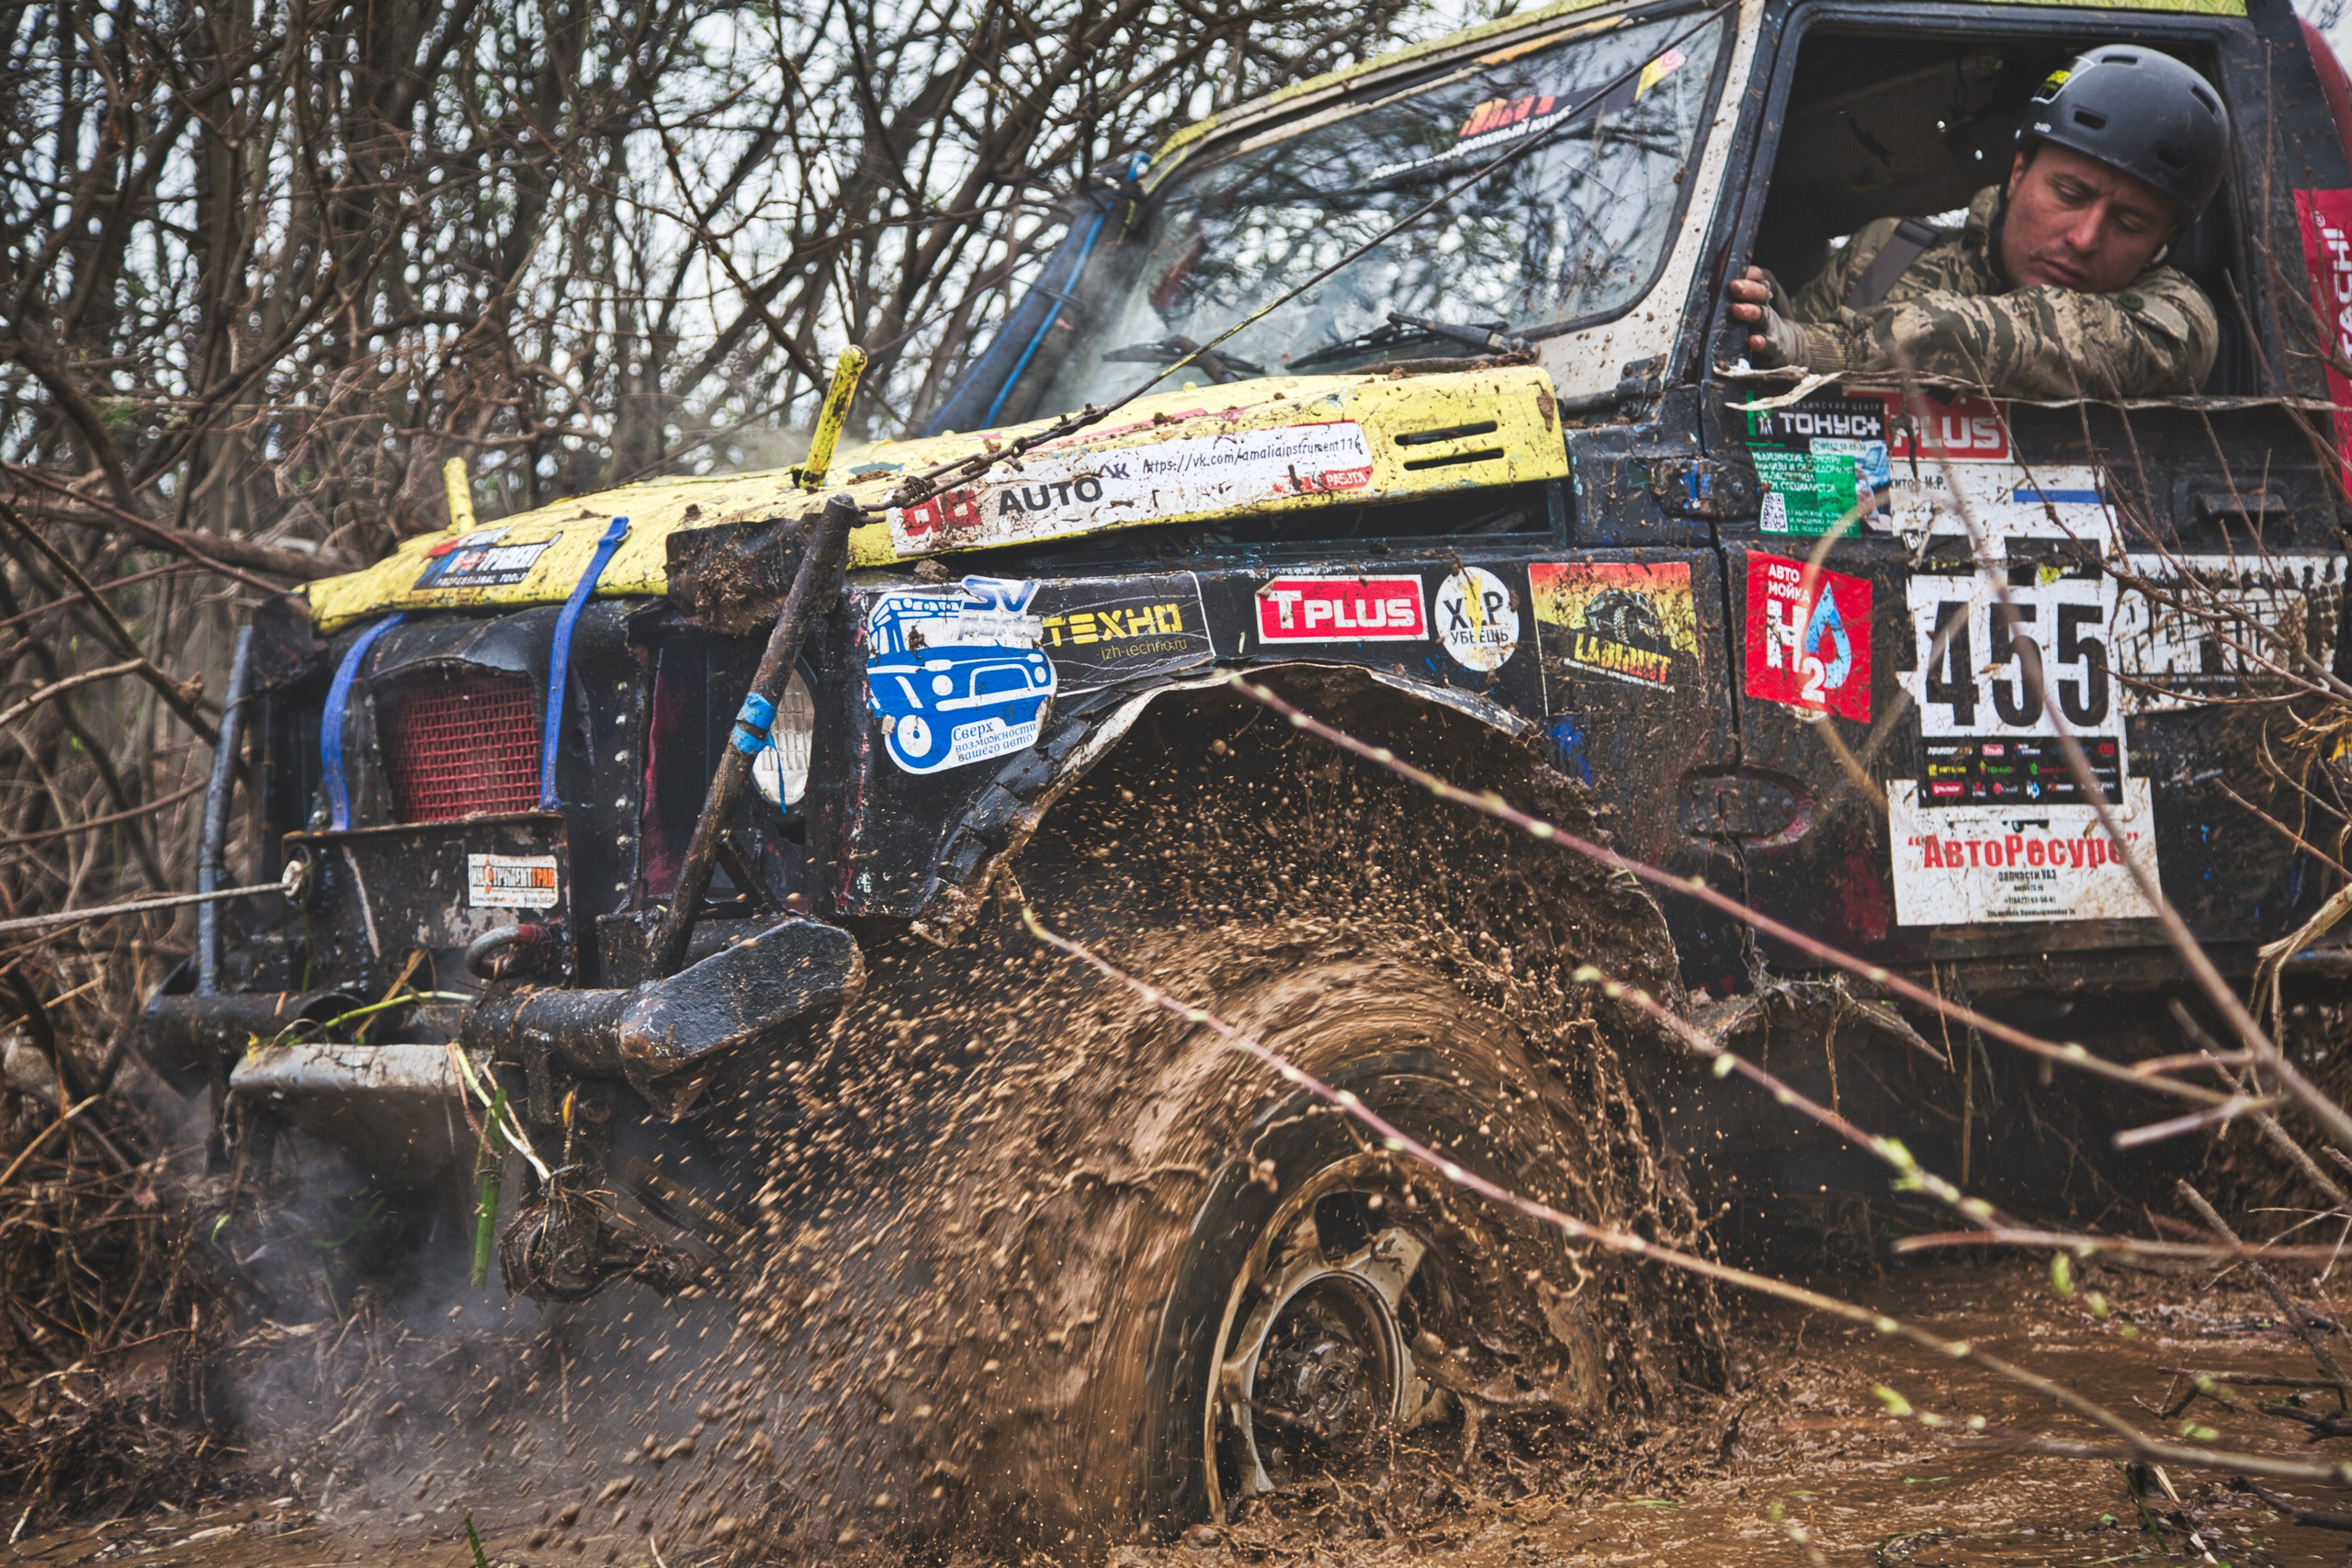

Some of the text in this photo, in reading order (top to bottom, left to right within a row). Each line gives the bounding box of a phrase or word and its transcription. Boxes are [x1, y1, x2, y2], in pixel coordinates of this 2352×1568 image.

[1779, 412, 1881, 436] ТОНУС+
[999, 476, 1103, 515] AUTO
[1768, 563, 1800, 581] АВТО
[1768, 581, 1811, 604] МОЙКА
[1443, 591, 1503, 631] ХР
[1926, 601, 2109, 727] 455
[953, 721, 994, 741] Сверх
[956, 723, 1037, 753] возможности
[958, 734, 1034, 762] вашего авто
